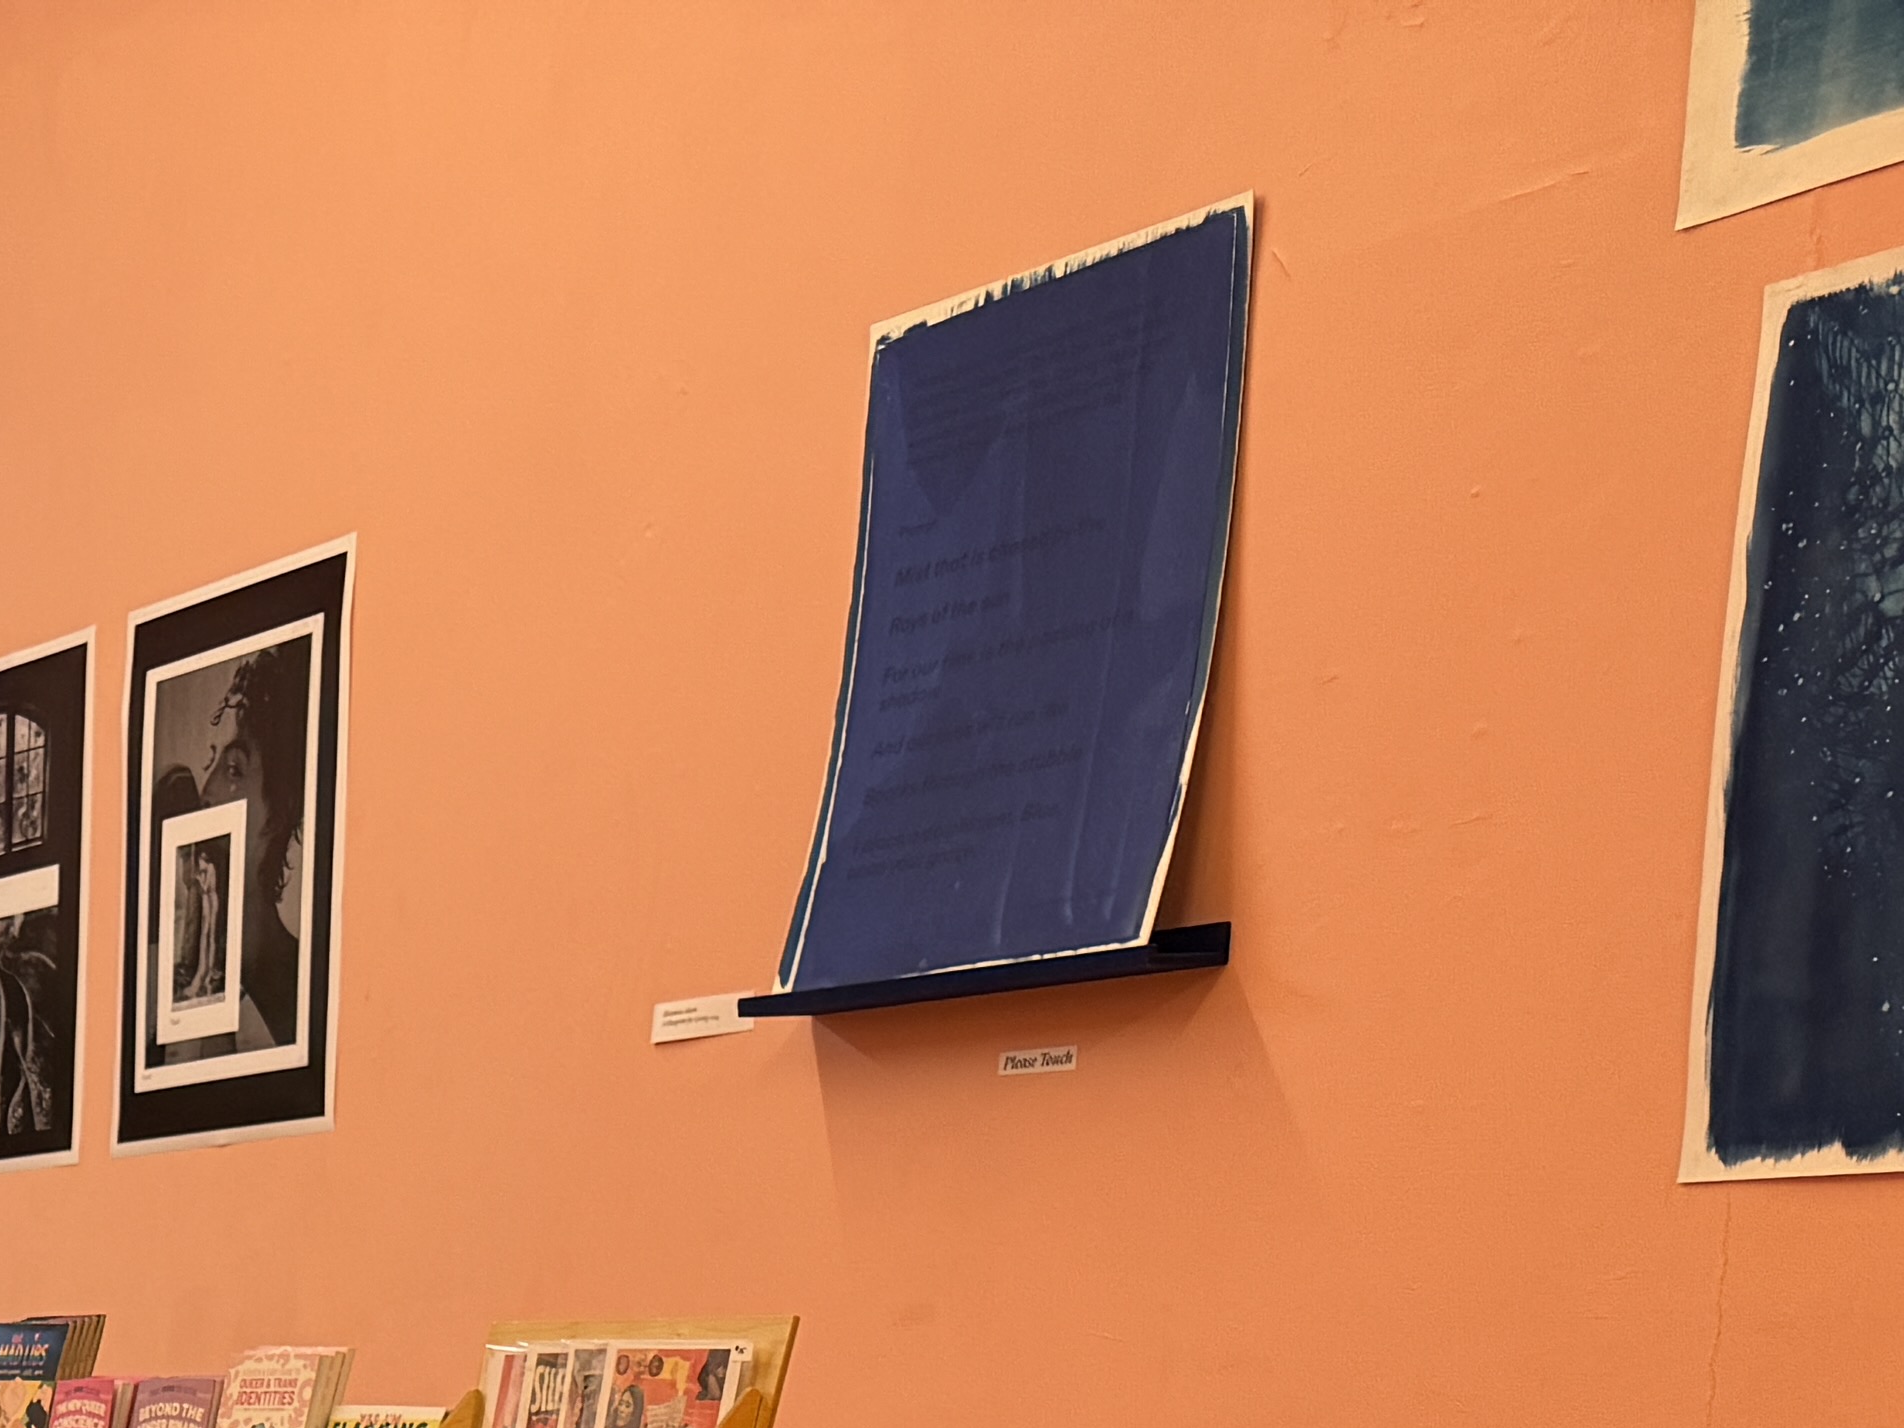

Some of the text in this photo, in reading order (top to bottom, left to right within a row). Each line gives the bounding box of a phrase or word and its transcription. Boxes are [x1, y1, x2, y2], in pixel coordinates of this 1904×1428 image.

[1003, 1050, 1074, 1071] Please Touch
[182, 1403, 205, 1420] THE
